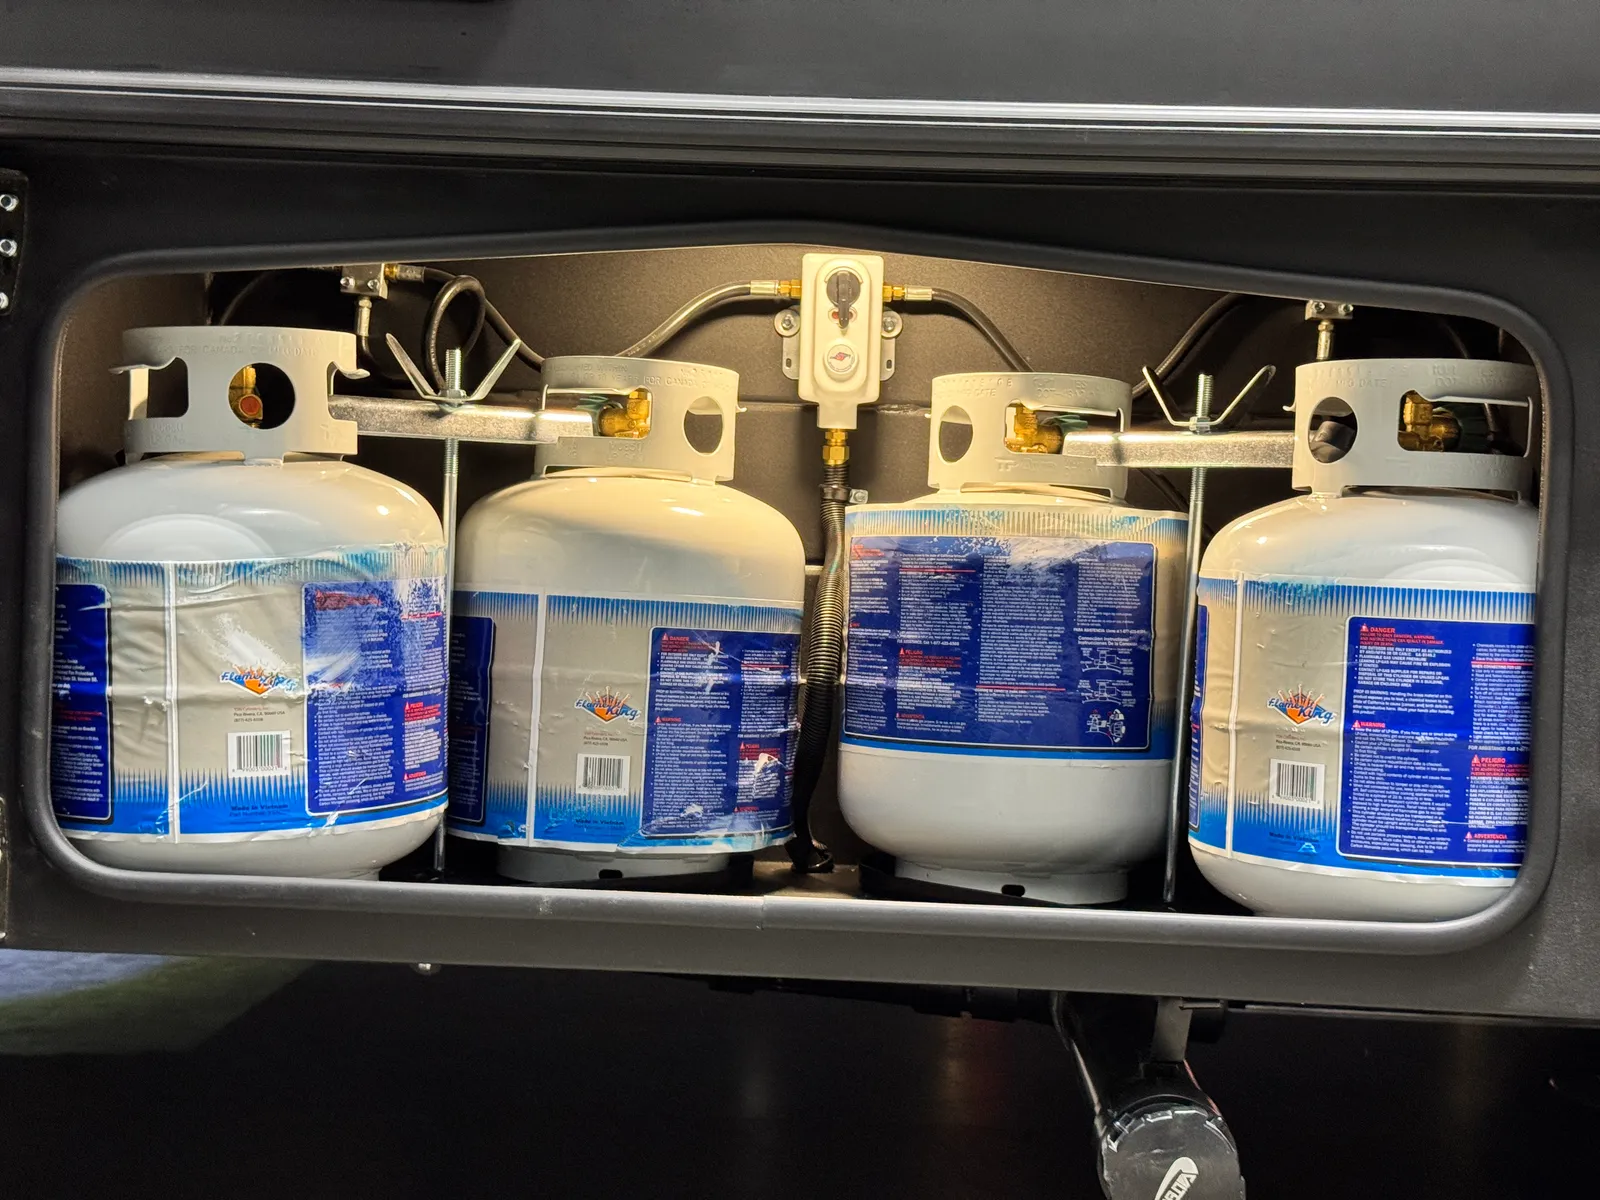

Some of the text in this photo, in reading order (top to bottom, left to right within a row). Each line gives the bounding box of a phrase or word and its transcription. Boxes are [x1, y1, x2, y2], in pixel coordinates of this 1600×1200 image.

[221, 672, 260, 681] Flame
[606, 706, 638, 720] King
[1269, 698, 1334, 724] Flame King
